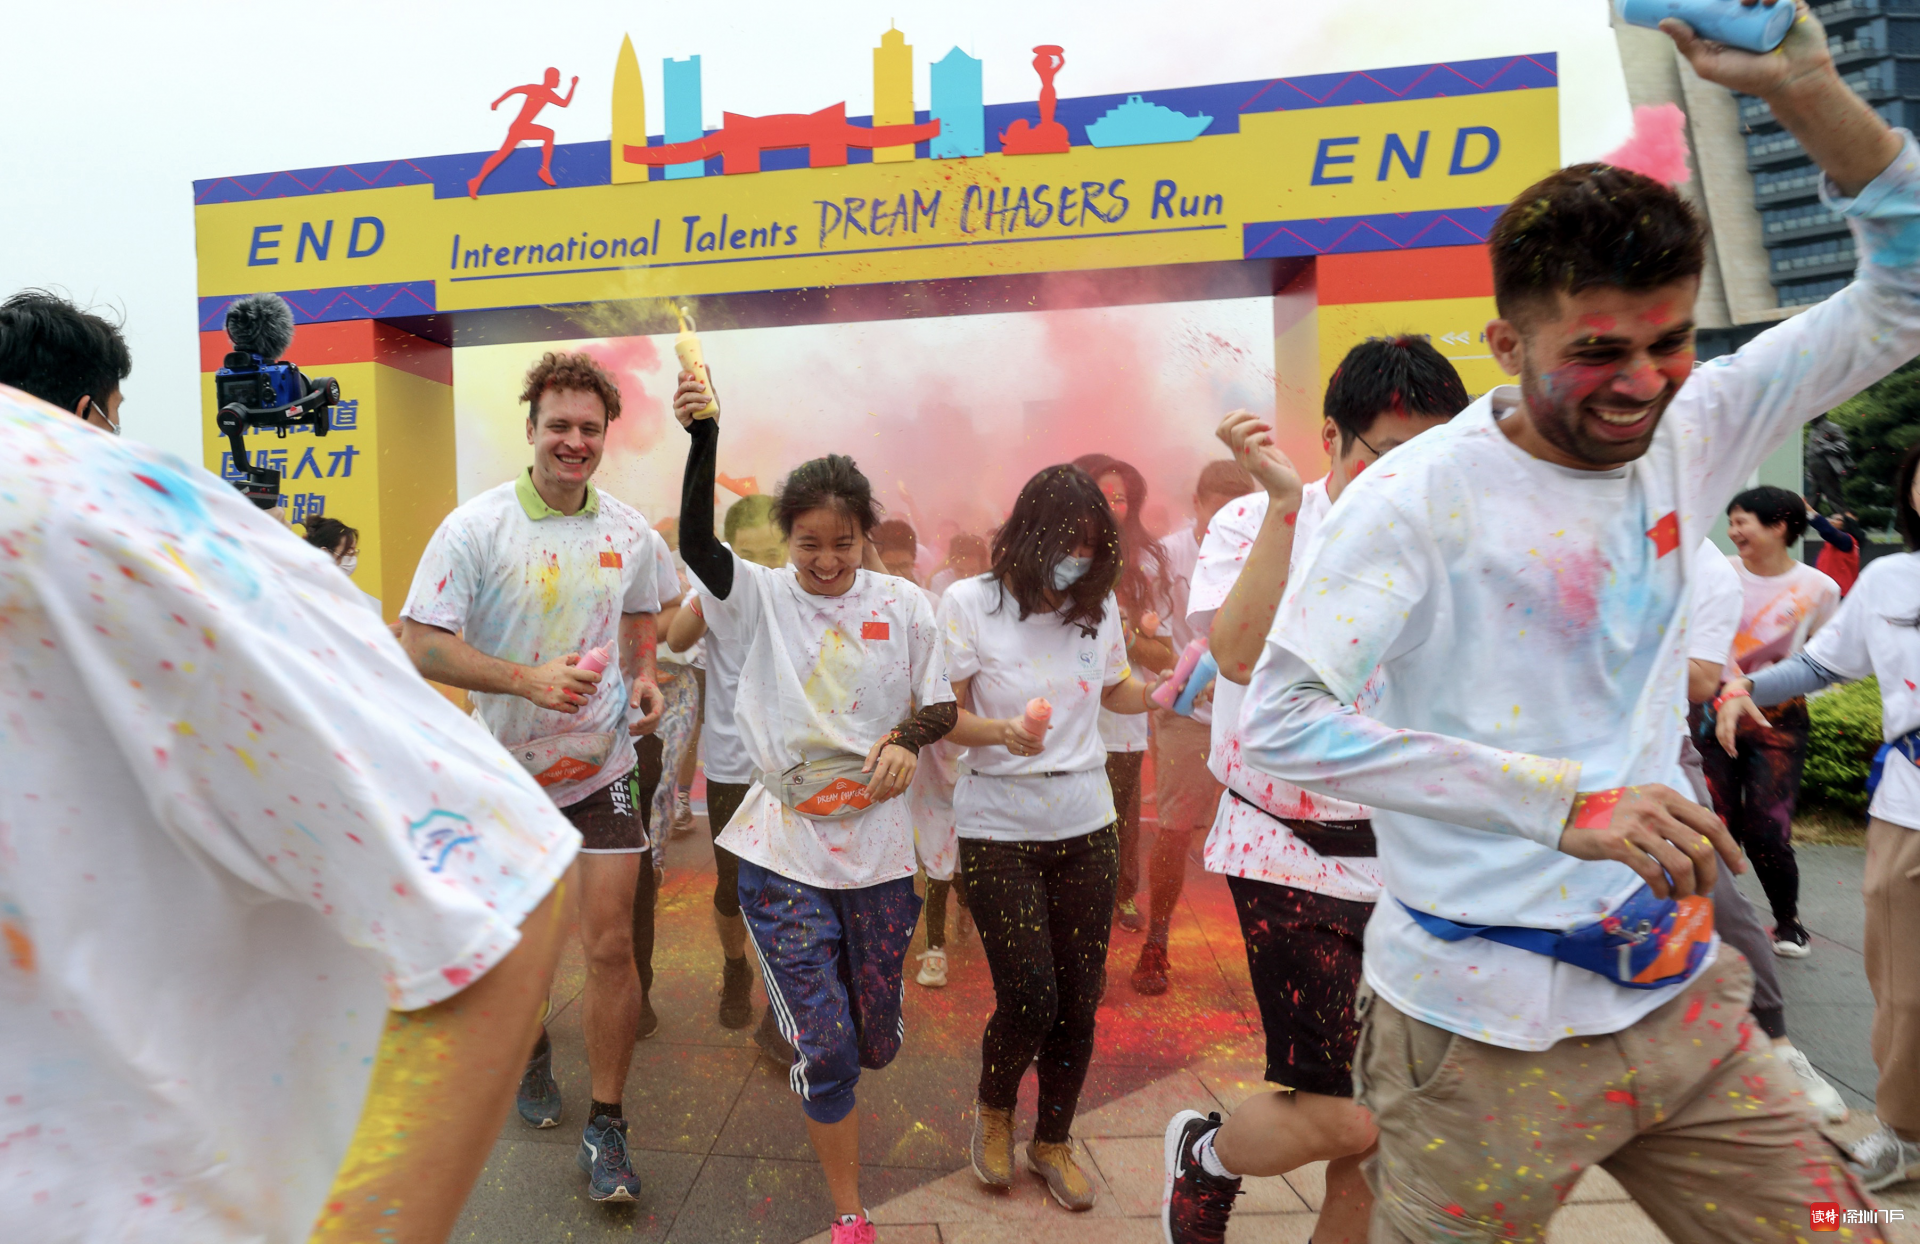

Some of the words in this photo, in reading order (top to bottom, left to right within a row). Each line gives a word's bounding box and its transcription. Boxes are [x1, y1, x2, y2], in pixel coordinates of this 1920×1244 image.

[1310, 125, 1501, 187] END
[248, 216, 386, 267] END
[451, 219, 661, 270] International
[682, 213, 798, 254] Talents
[813, 189, 942, 249] DREAM
[960, 178, 1129, 236] CHASERS
[1151, 179, 1224, 220] Run
[220, 445, 360, 481] 国际人才
[609, 779, 628, 816] EEK
[816, 793, 839, 805] DREAM
